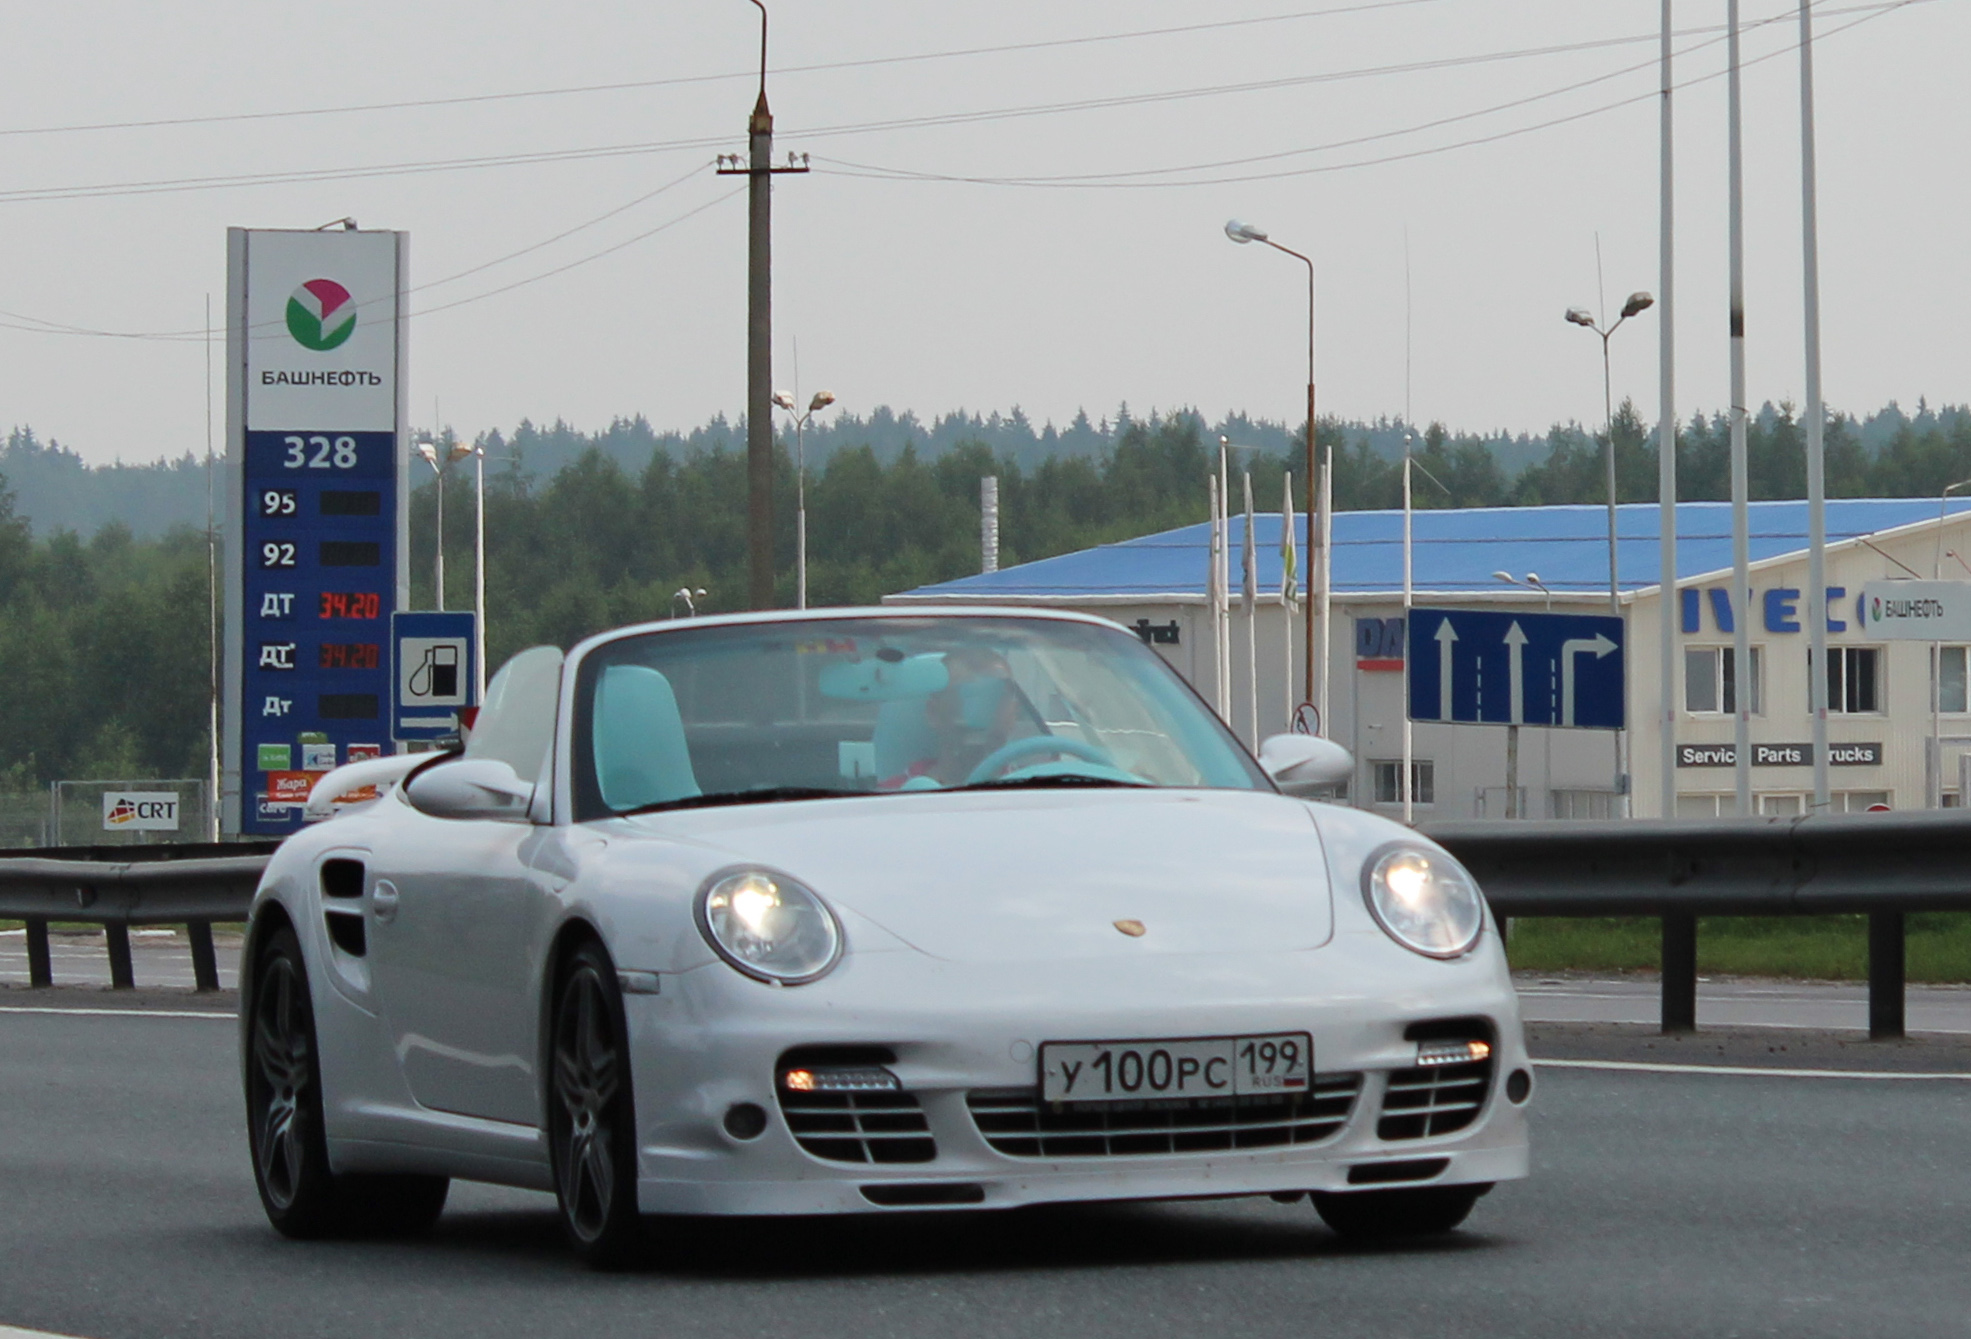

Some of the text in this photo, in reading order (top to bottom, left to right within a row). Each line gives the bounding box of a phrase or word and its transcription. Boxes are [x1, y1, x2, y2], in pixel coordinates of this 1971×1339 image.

[262, 370, 382, 386] БАШНЕФТЬ
[283, 435, 358, 468] 328
[264, 491, 296, 514] 95
[263, 543, 295, 566] 92
[260, 592, 380, 620] ДТ 34.20
[1682, 587, 1865, 633] IVEC
[1885, 598, 1944, 619] БАШНЕФТЬ
[1683, 746, 1875, 763] Servic Parts rucks
[137, 801, 176, 819] CRT
[1240, 1040, 1298, 1074] 199
[1252, 1076, 1282, 1087] RUS
